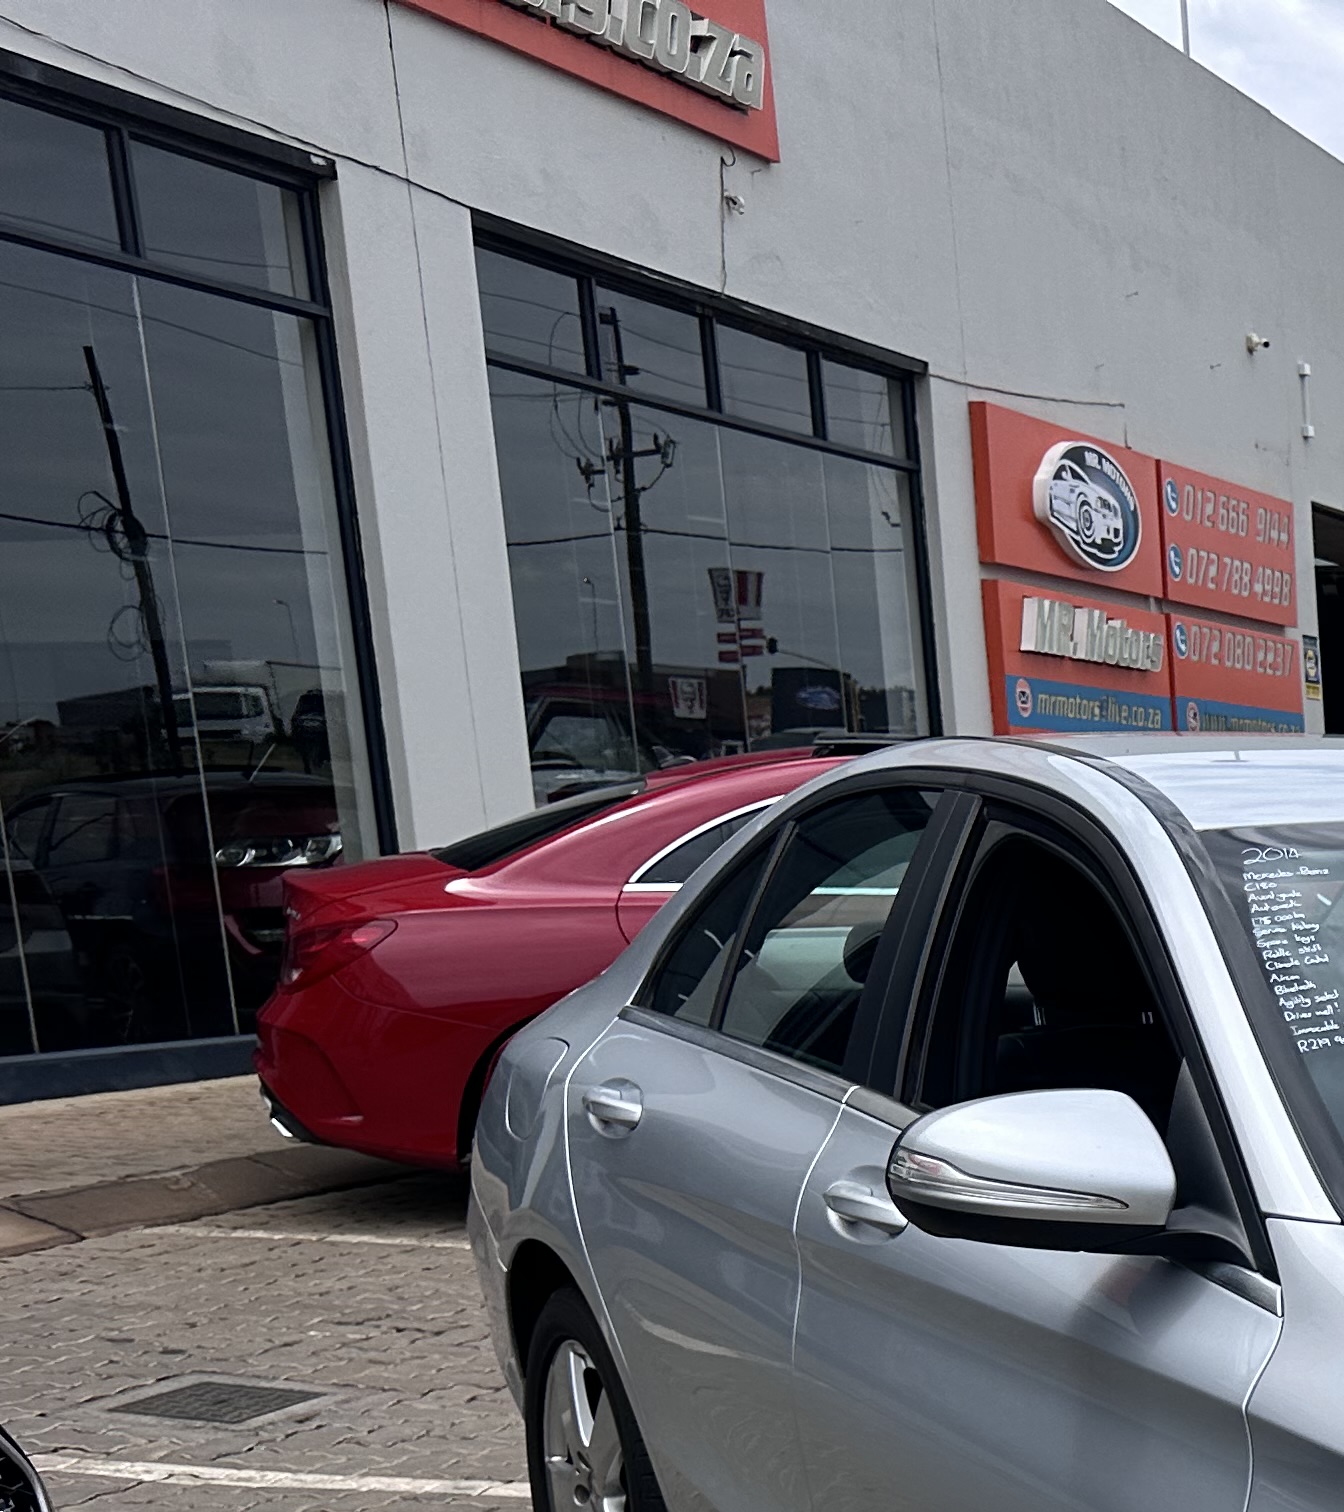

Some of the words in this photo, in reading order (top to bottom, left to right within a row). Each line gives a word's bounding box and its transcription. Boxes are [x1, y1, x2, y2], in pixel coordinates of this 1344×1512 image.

[1184, 484, 1215, 528] 012
[1218, 494, 1249, 537] 666
[1255, 507, 1290, 549] 9144
[1187, 546, 1219, 590] 072
[1222, 556, 1251, 597] 788
[1254, 570, 1291, 606] 4998
[1028, 597, 1079, 654] MR.
[1082, 606, 1163, 673] Motors
[1191, 621, 1221, 665] 072
[1224, 629, 1254, 671] 080
[1256, 637, 1294, 677] 2237
[1241, 848, 1302, 865] 2014
[1244, 881, 1278, 892] C180
